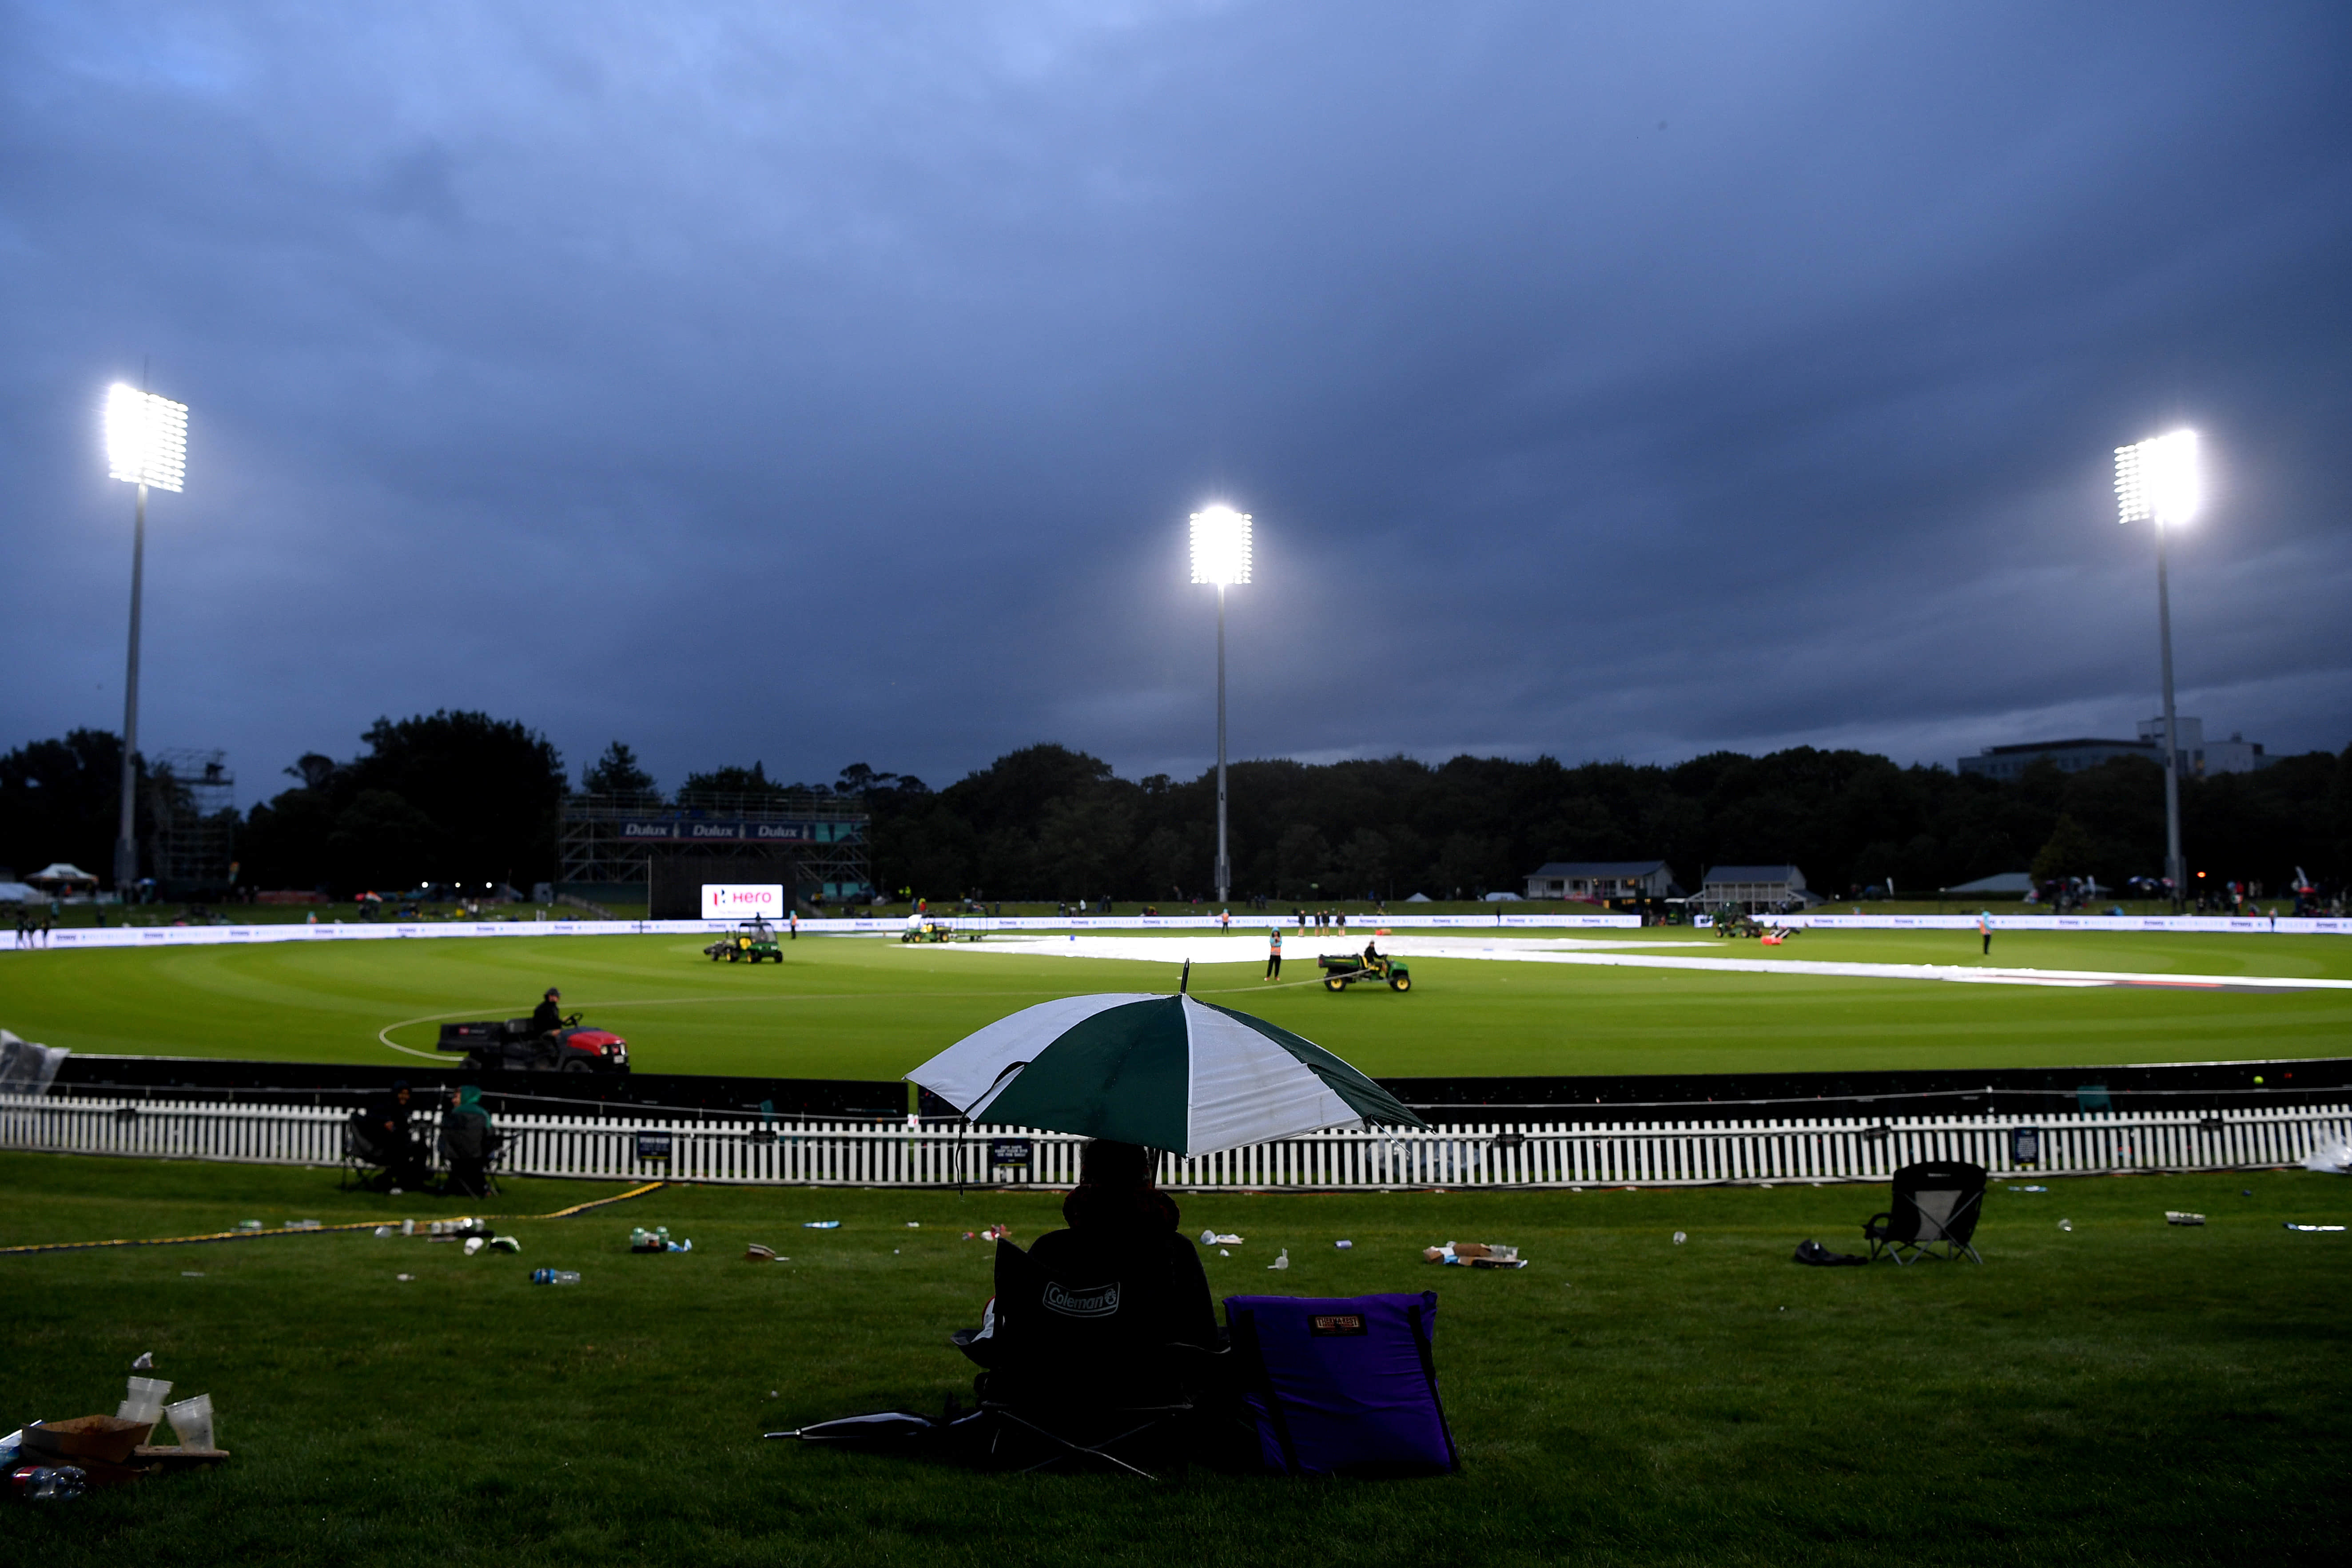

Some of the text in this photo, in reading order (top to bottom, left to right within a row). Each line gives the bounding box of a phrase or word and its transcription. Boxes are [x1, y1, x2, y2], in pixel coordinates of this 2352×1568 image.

[625, 823, 668, 836] Dulux
[692, 824, 735, 837] Dulux
[757, 825, 797, 837] Dulux
[1049, 1286, 1104, 1309] Coleman
